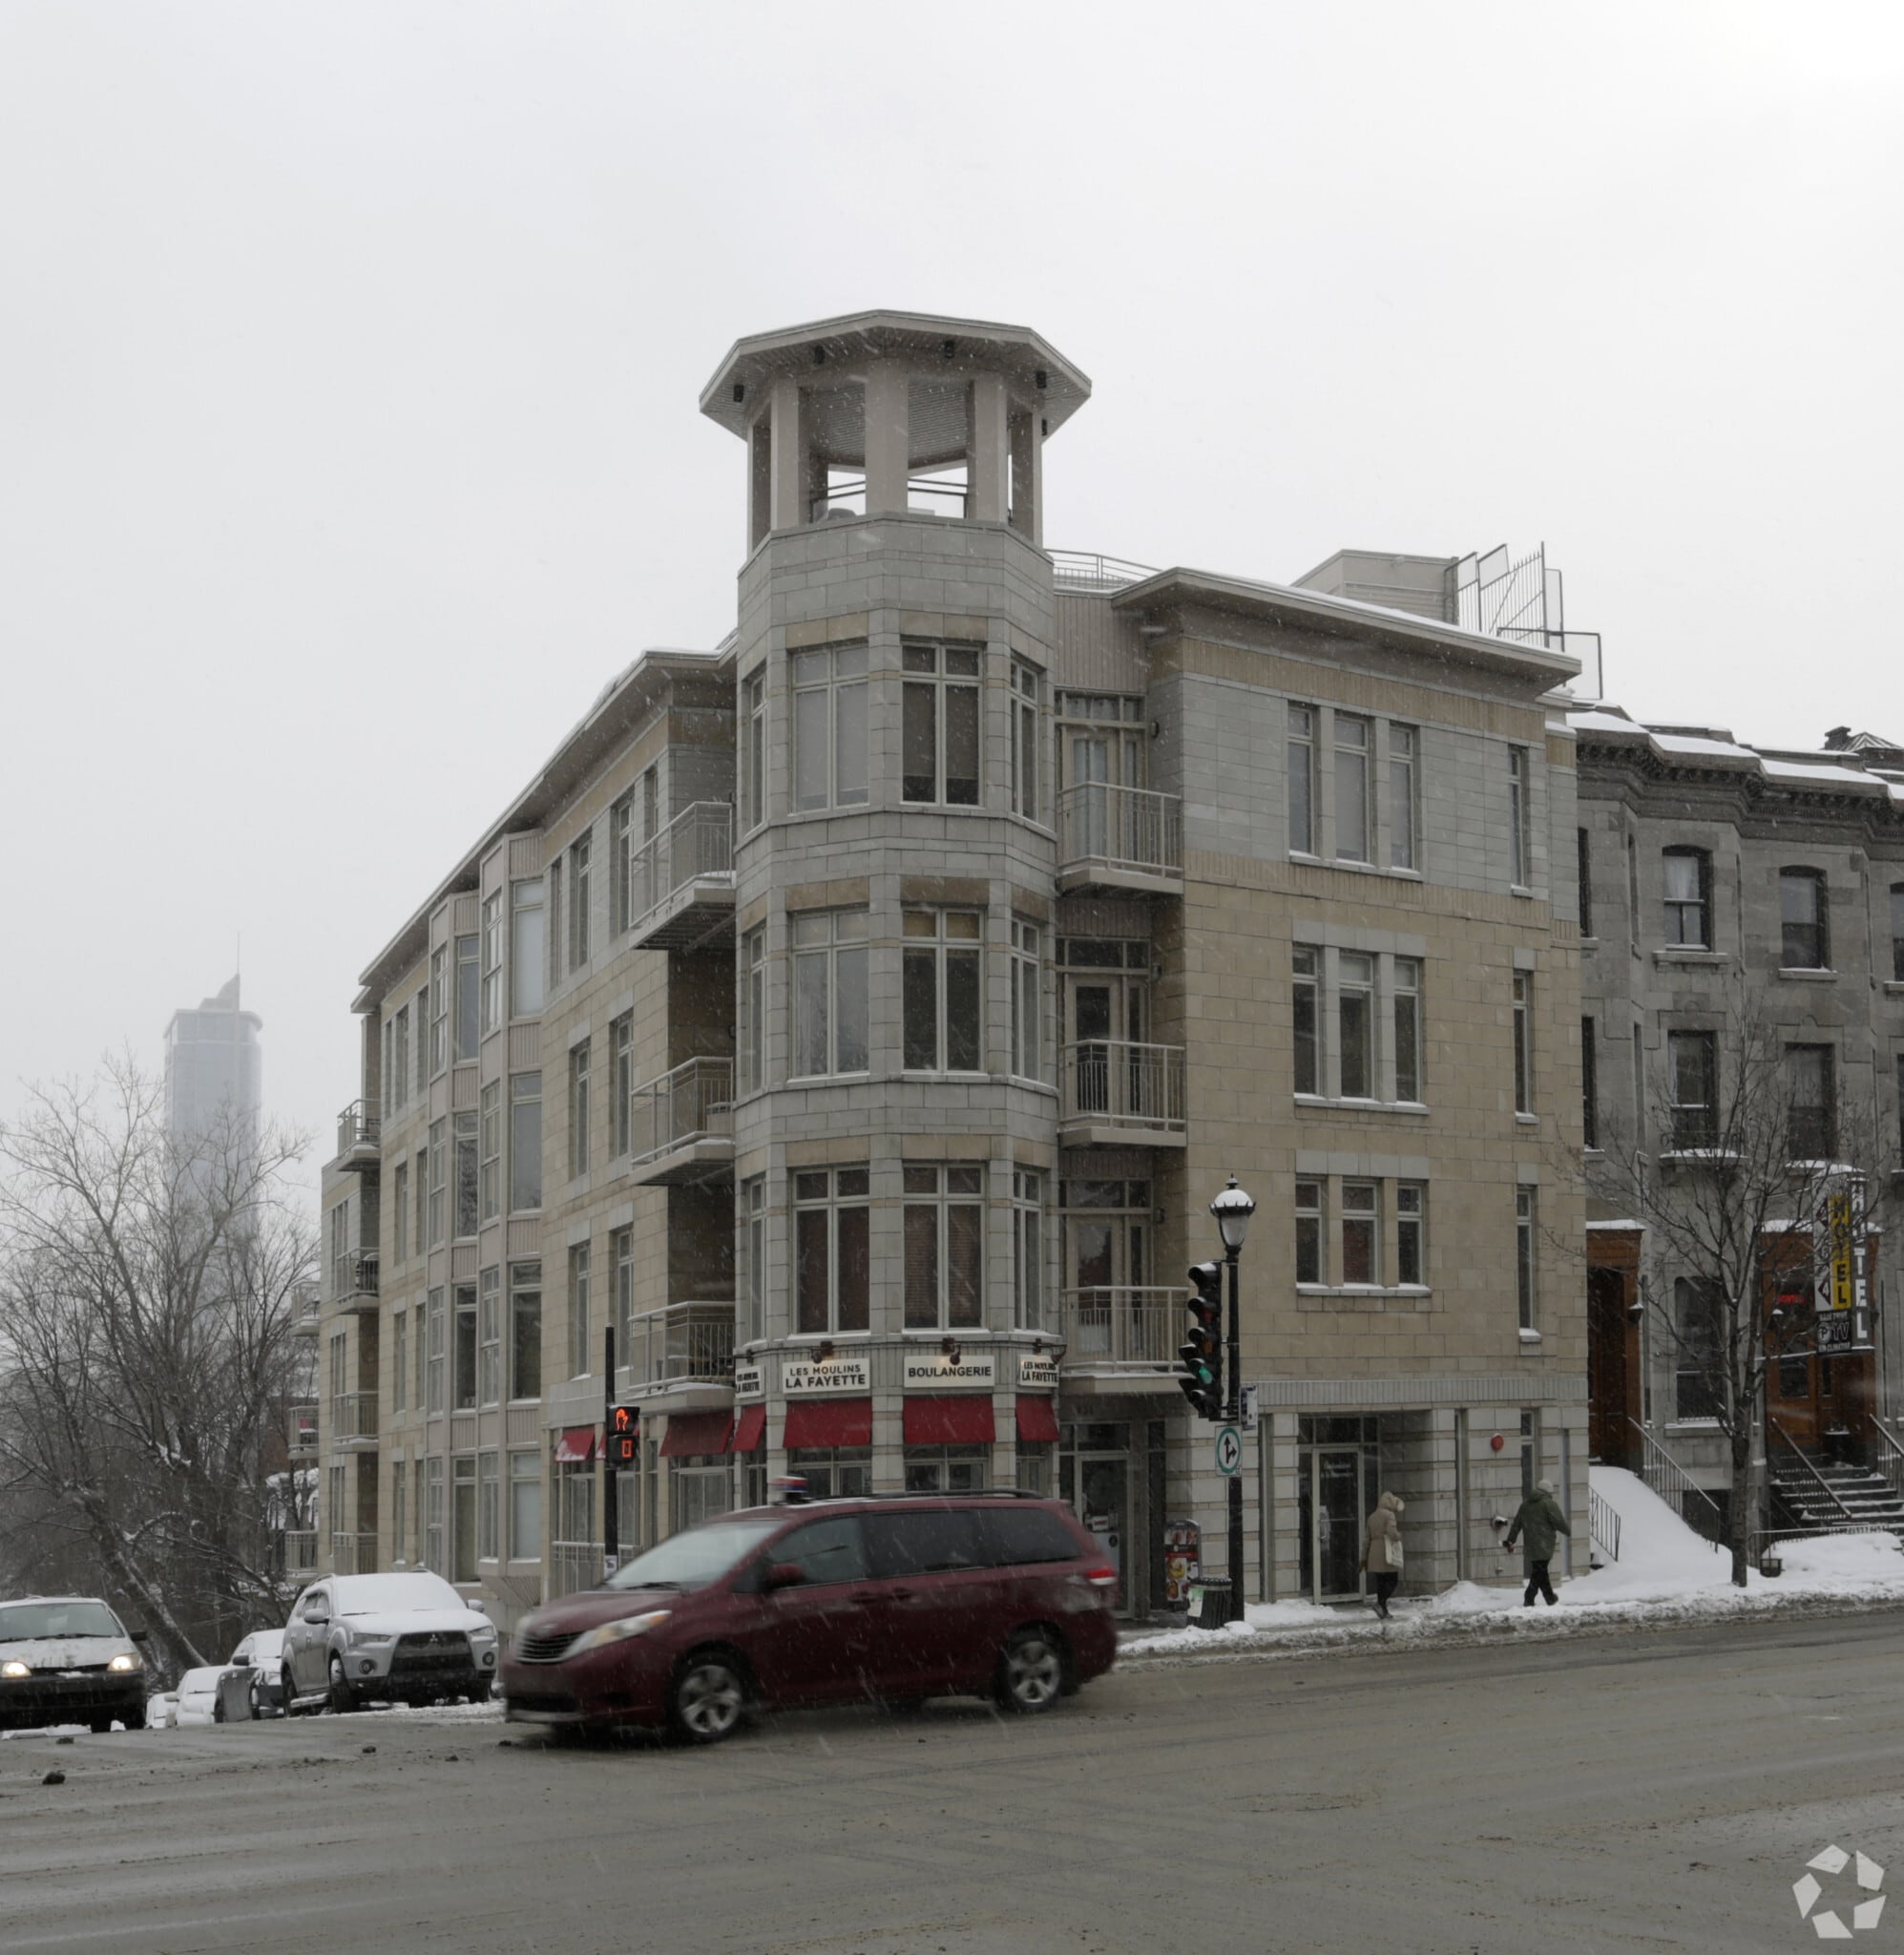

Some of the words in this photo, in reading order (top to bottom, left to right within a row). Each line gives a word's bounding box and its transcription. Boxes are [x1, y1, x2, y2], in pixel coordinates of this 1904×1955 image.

[789, 1367, 808, 1377] LES
[812, 1364, 861, 1375] MOULINS
[908, 1366, 992, 1377] BOULANGERIE
[1022, 1371, 1031, 1380] LA
[785, 1377, 803, 1388] LA
[807, 1375, 866, 1387] FAYETTE
